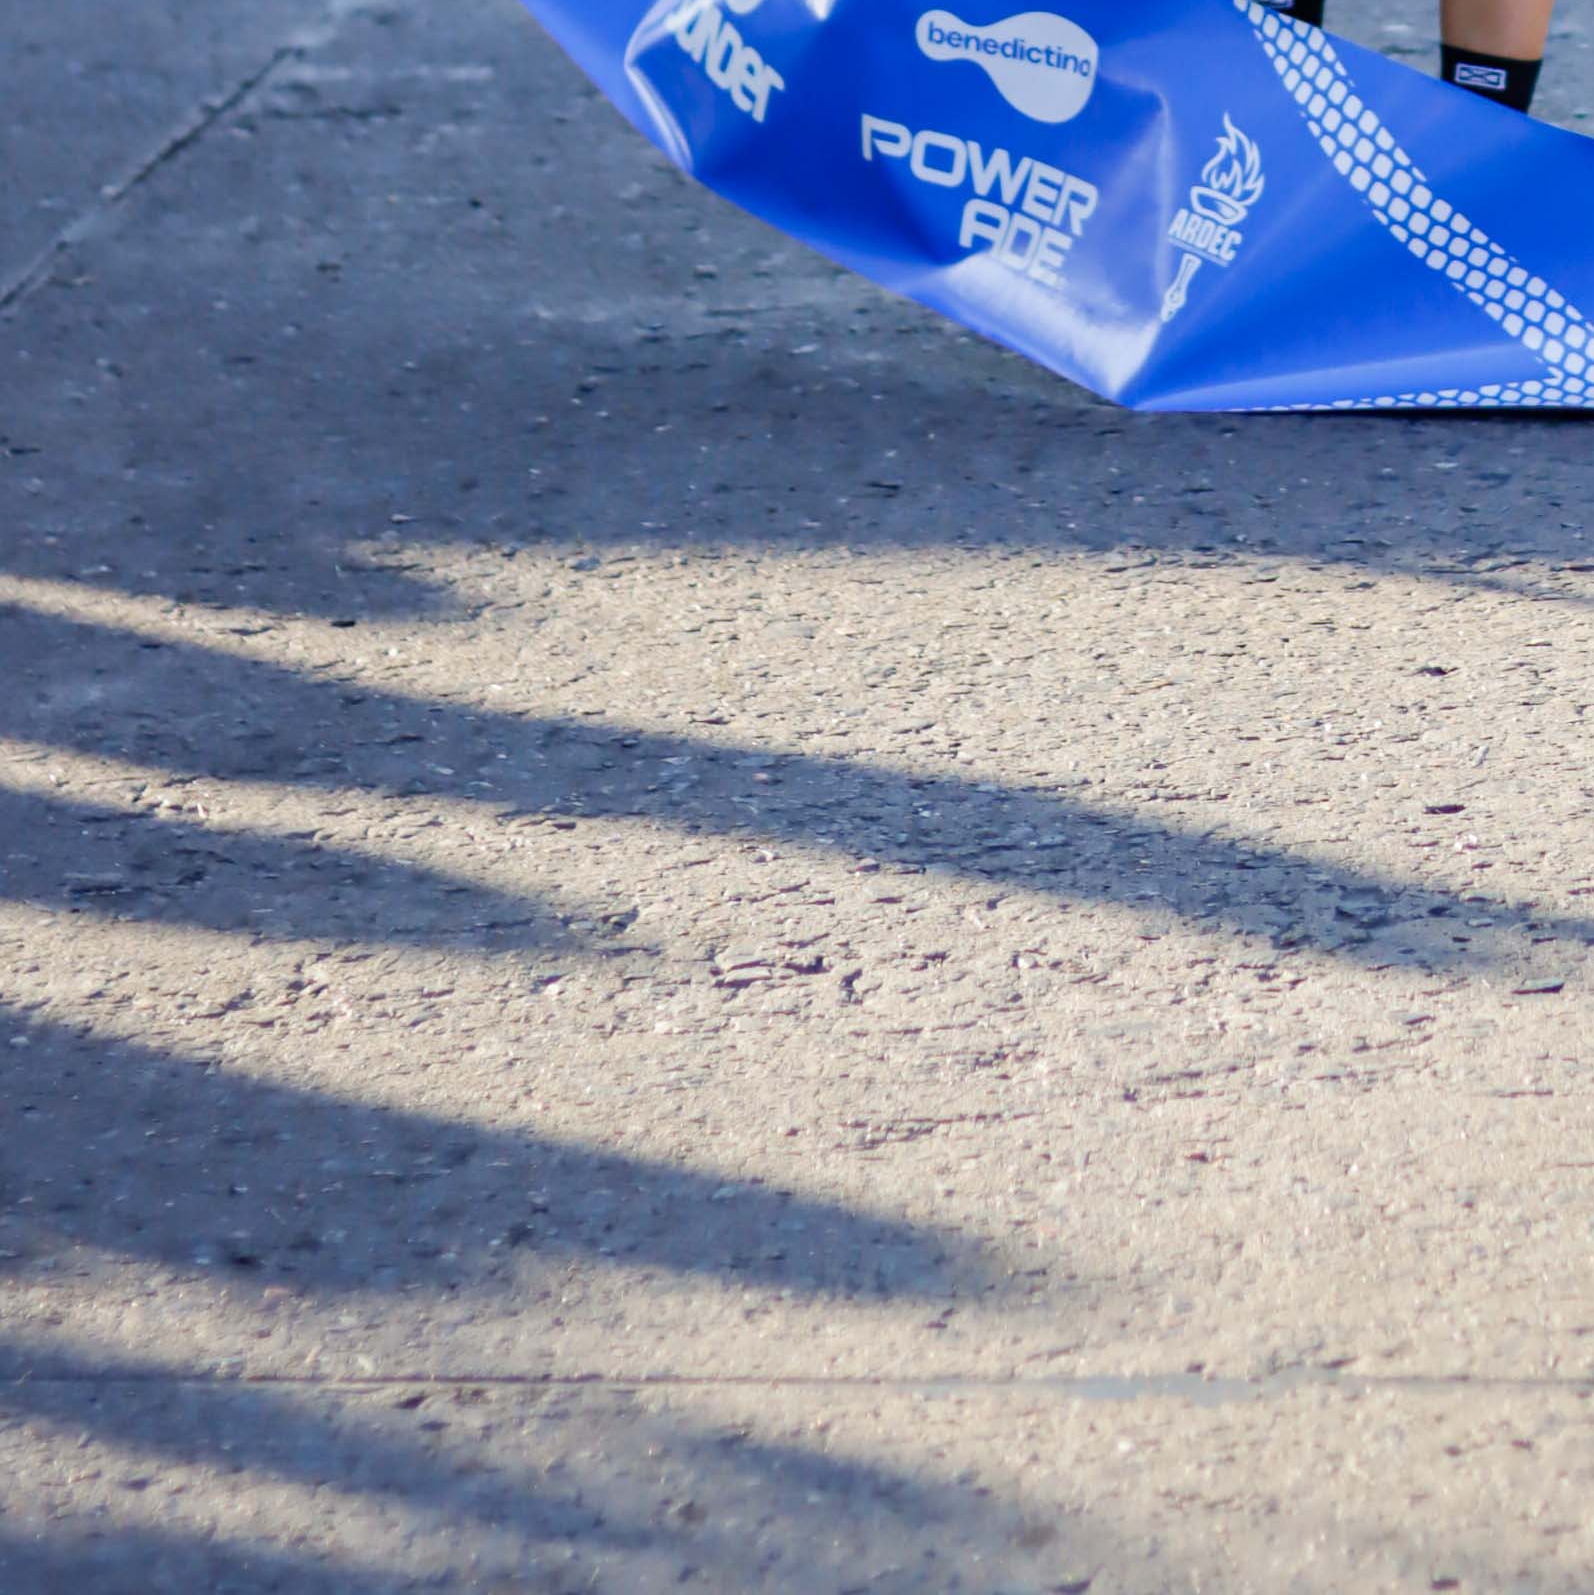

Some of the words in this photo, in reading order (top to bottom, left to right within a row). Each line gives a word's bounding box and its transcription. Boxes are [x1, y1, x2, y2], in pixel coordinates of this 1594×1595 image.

[927, 20, 1092, 78] benedictino
[860, 112, 1099, 237] POWER
[958, 197, 1073, 288] ADE
[1168, 207, 1243, 262] ARDEC
